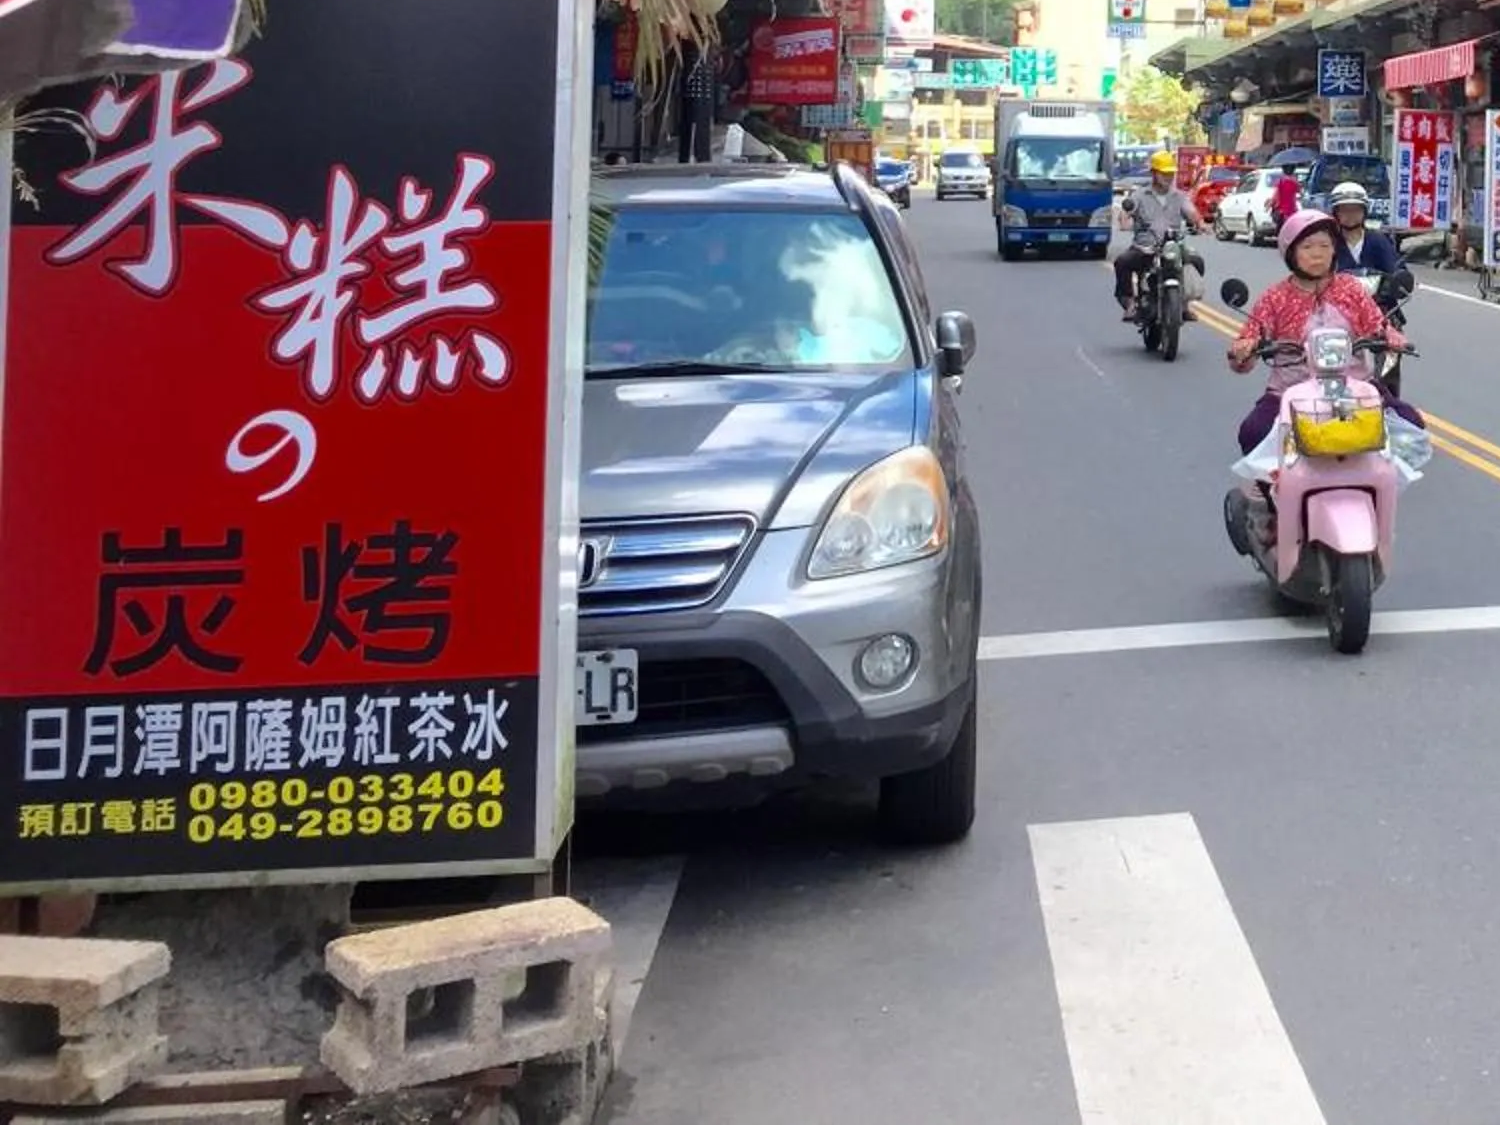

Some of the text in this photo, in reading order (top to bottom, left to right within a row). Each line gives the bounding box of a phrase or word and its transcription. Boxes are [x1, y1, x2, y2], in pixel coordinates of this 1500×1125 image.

[1323, 56, 1362, 92] 藥
[47, 58, 511, 405] 米糕
[225, 408, 318, 503] の
[84, 519, 461, 677] 炭烤
[22, 688, 511, 782] 日月潭阿薩姆紅茶冰
[18, 796, 177, 841] 預訂電話
[188, 767, 506, 812] 0980-033404
[188, 800, 504, 843] 049-2898760
